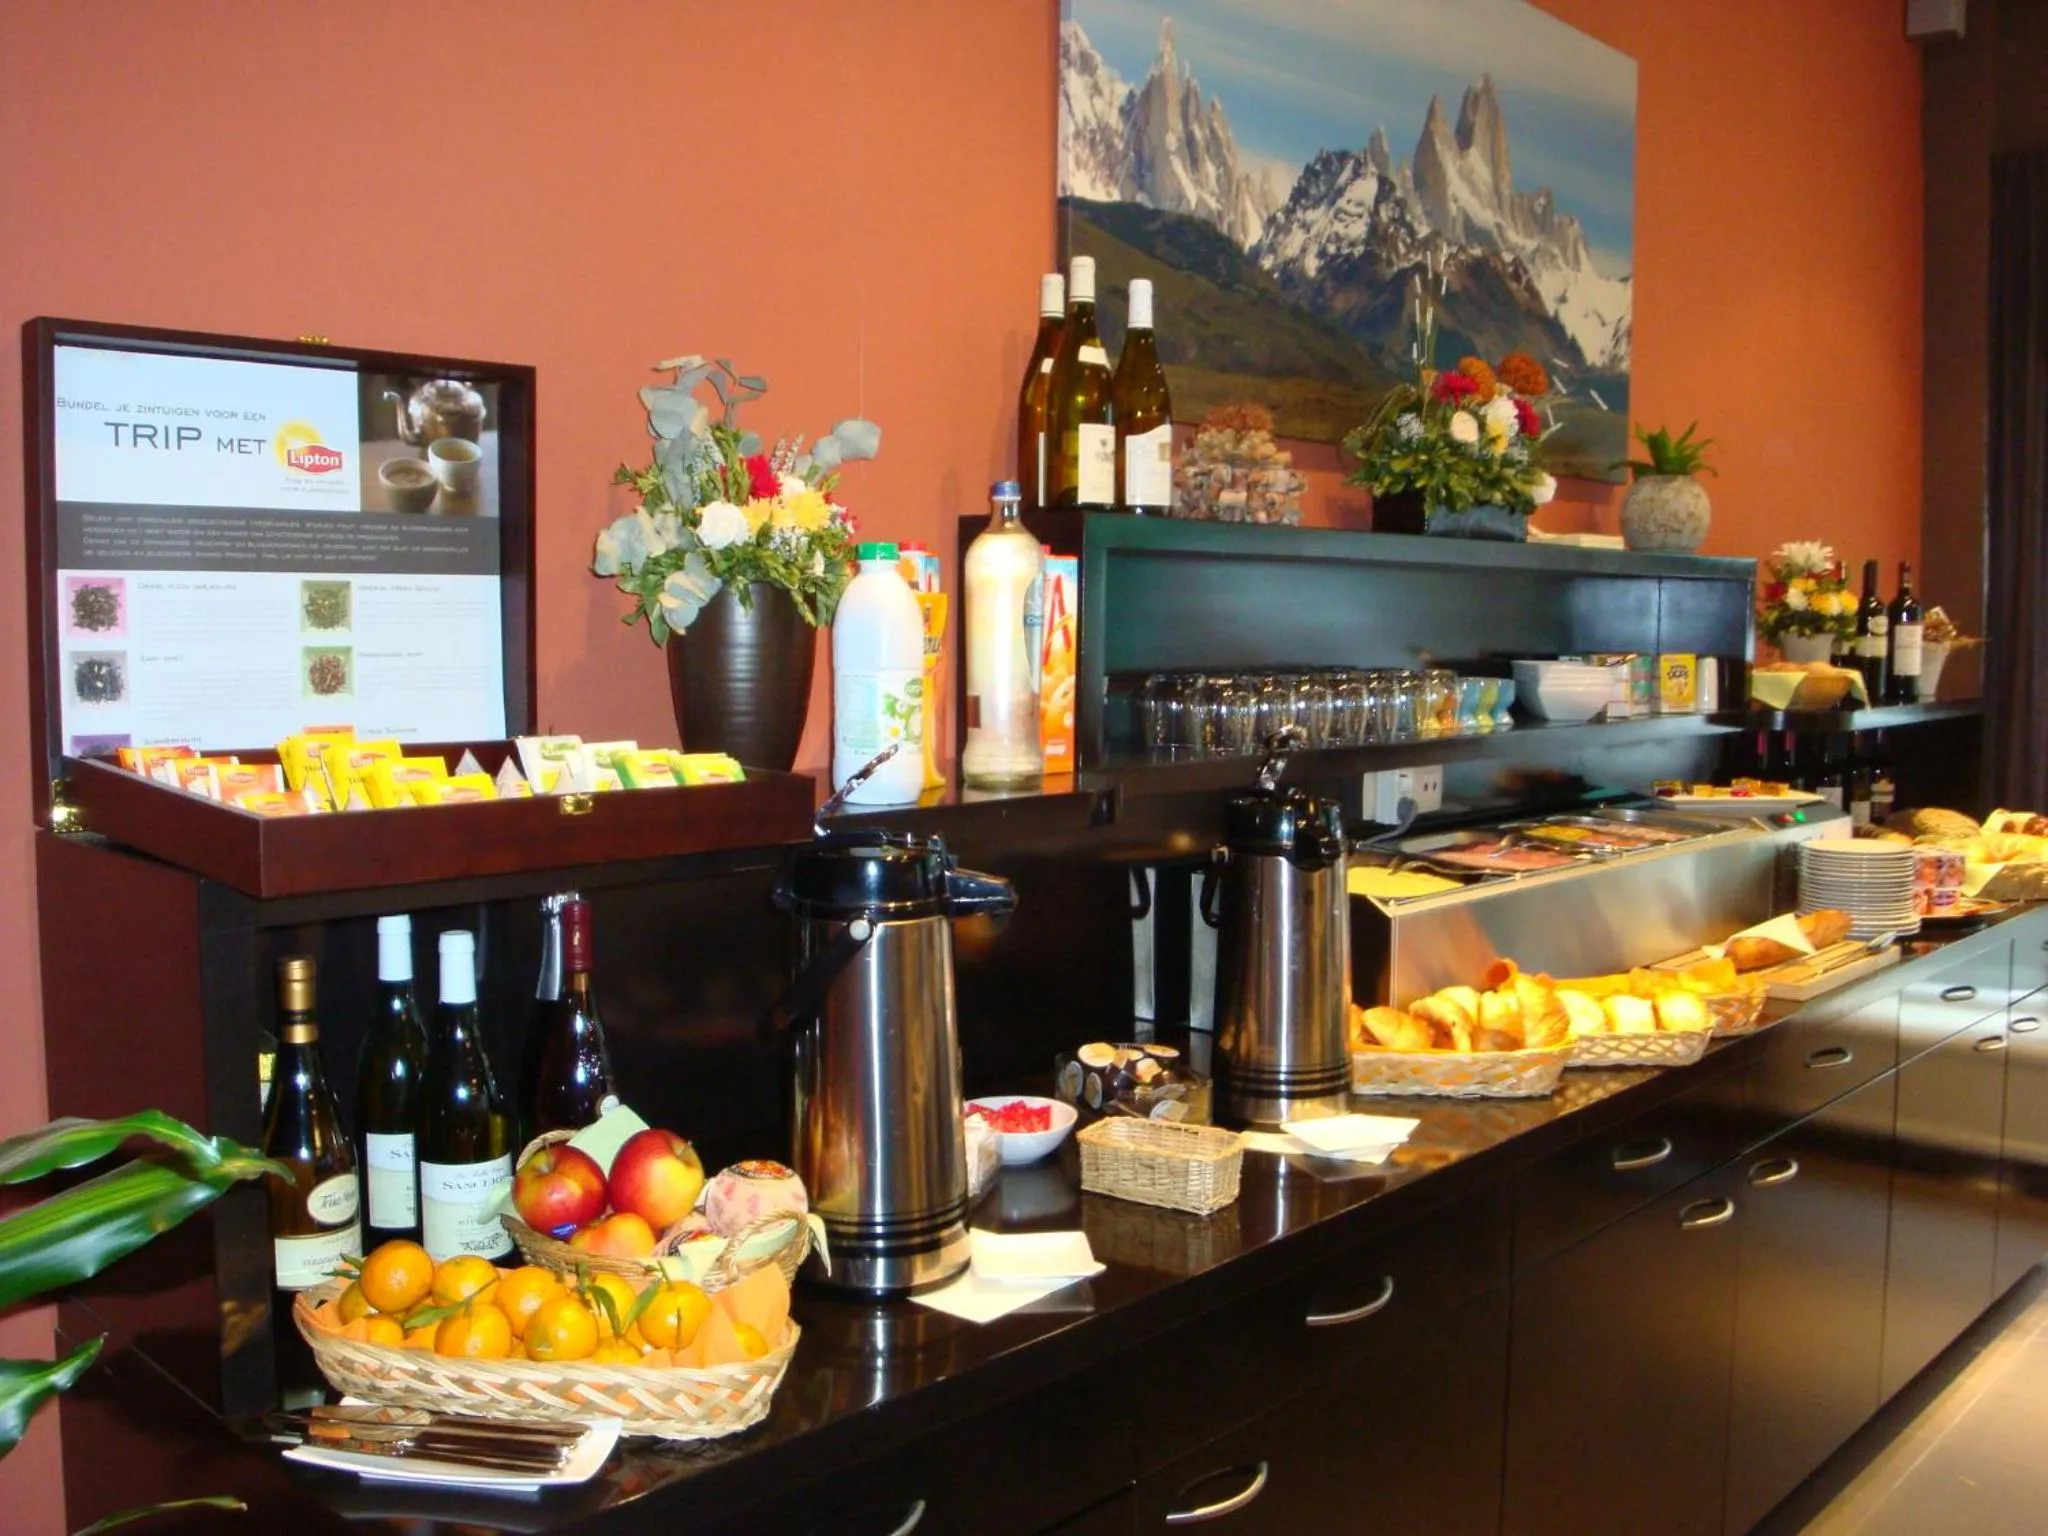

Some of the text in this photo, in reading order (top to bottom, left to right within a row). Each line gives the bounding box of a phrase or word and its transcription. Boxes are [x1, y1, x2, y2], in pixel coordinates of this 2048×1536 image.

[56, 397, 109, 412] BUNDEL
[115, 403, 131, 412] JE
[136, 404, 200, 417] ZINTUIGEN
[205, 408, 239, 419] VOOR
[103, 420, 267, 455] TRIP MET
[288, 450, 341, 468] Lipton
